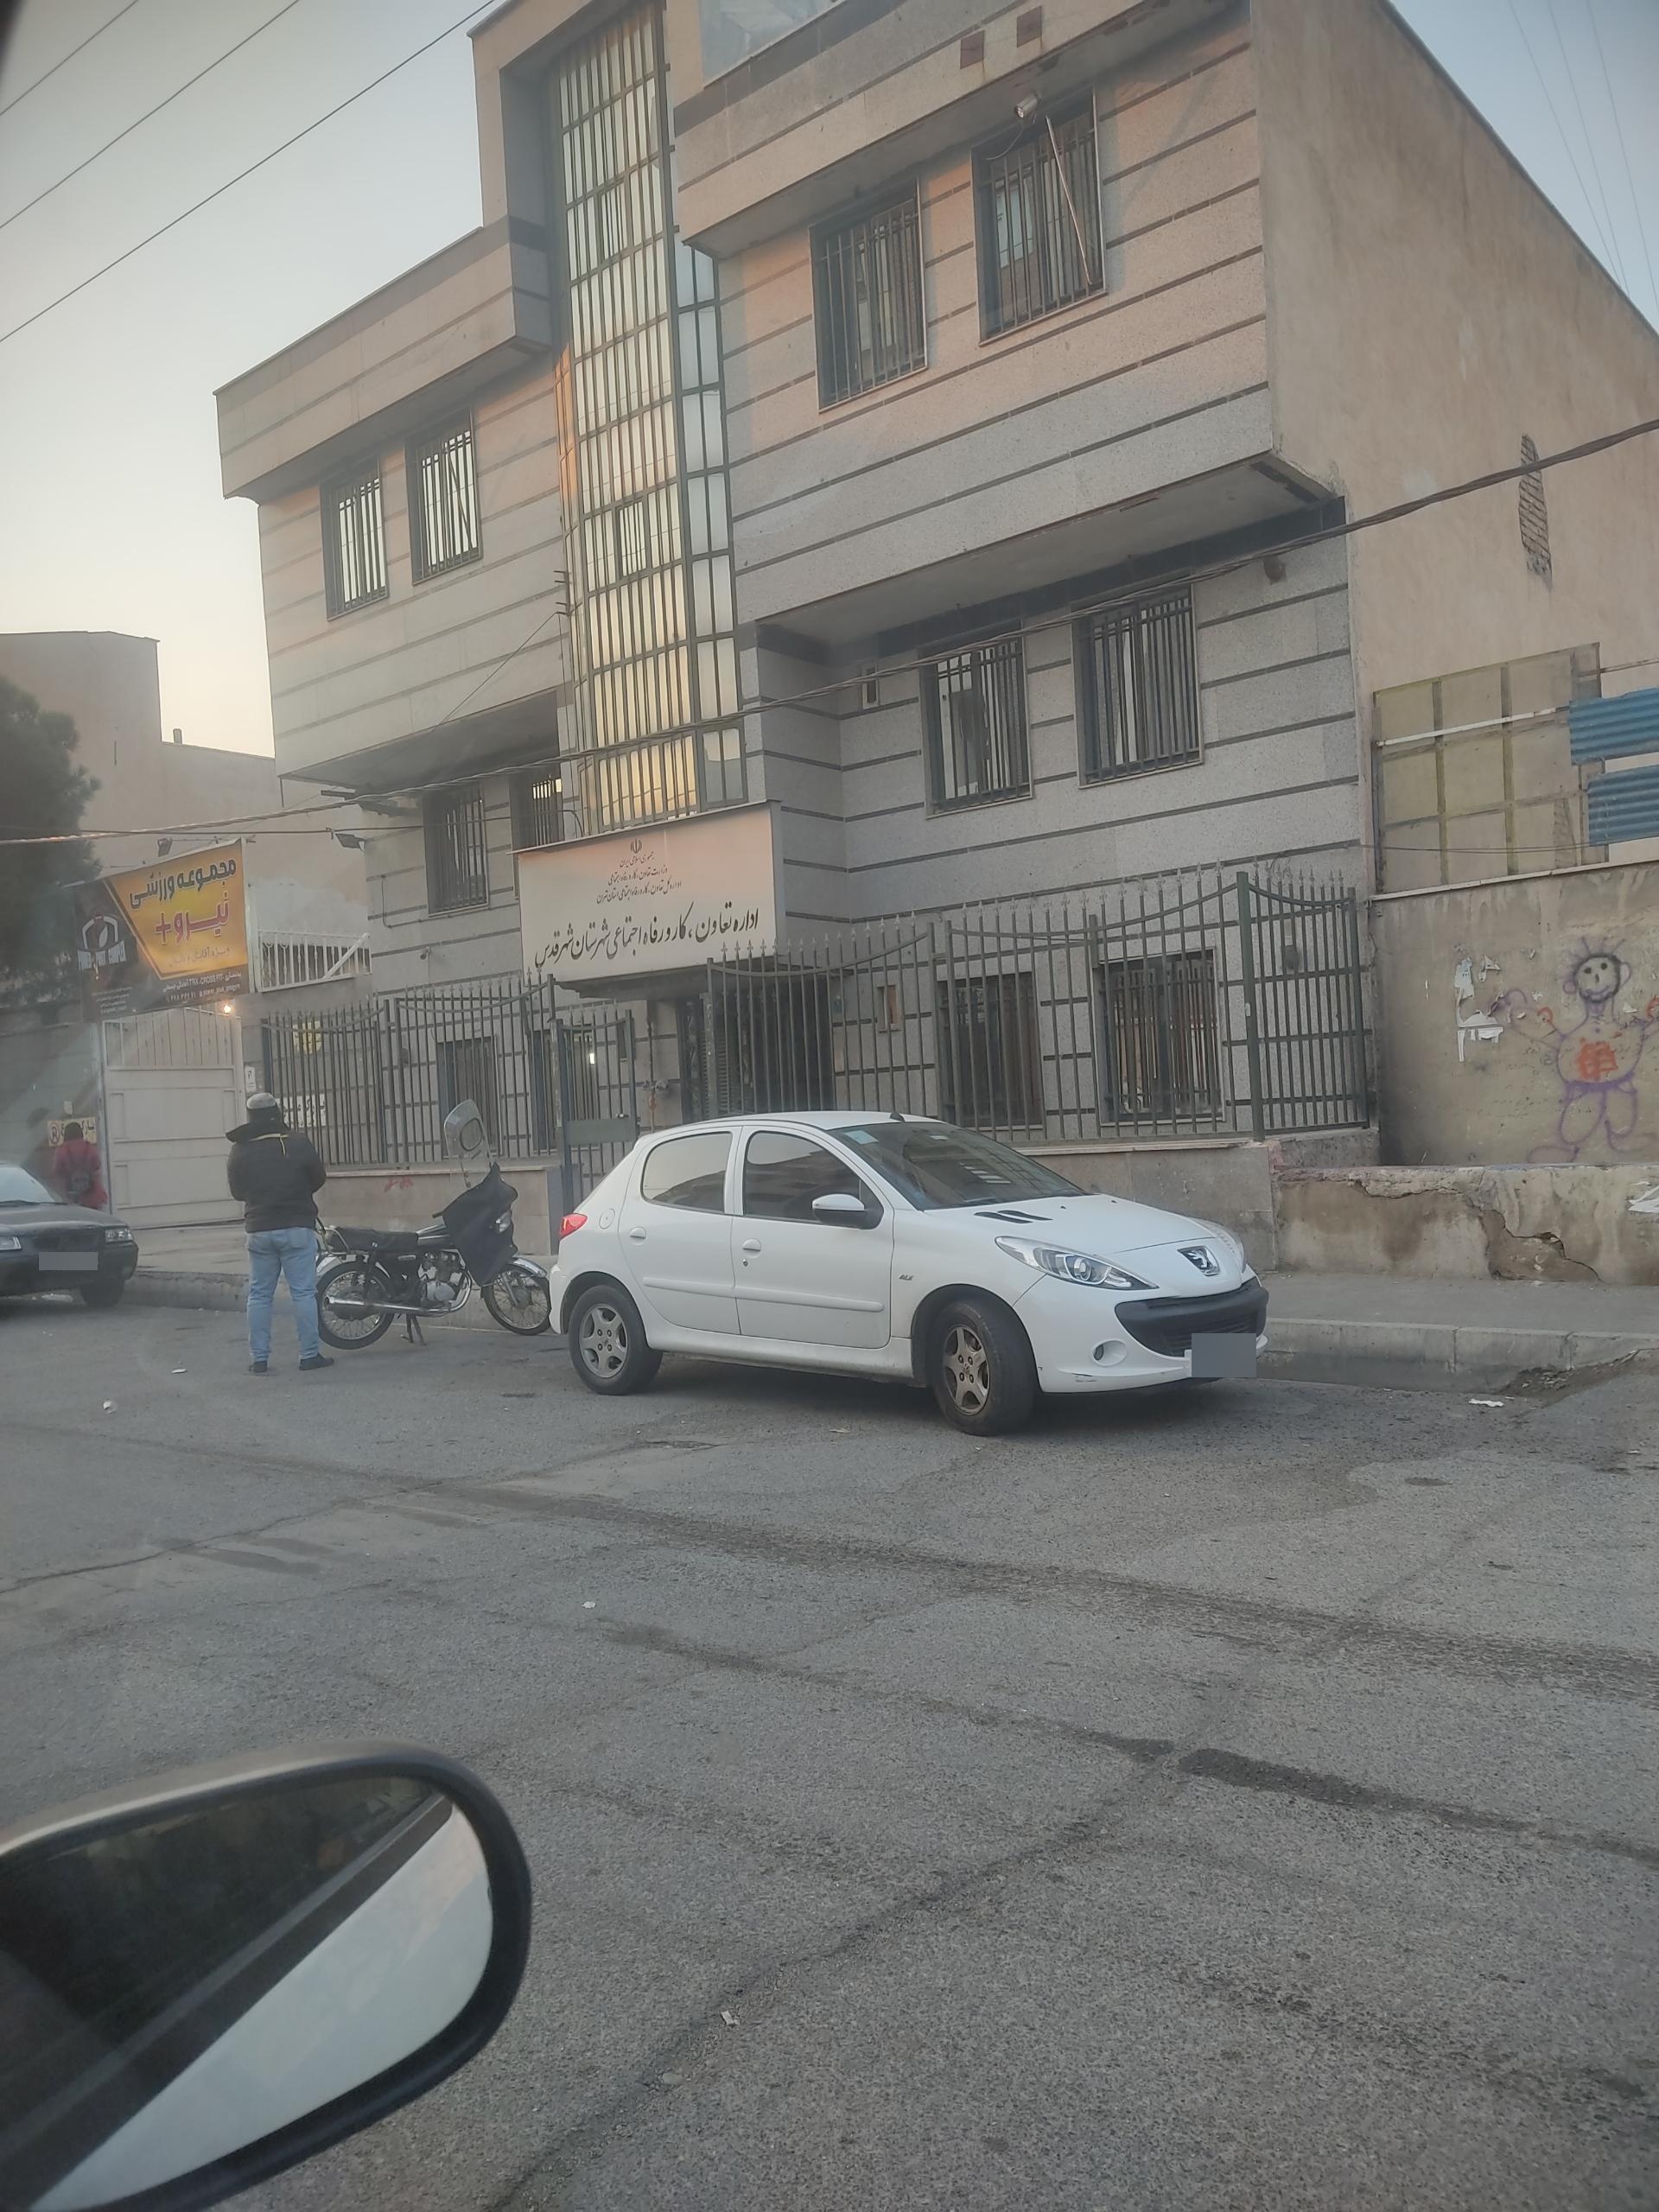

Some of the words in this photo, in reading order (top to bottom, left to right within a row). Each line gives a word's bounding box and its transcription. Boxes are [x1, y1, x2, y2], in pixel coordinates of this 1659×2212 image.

[130, 872, 175, 909] ورزشی
[176, 859, 237, 893] مجموعه
[607, 915, 642, 960] اجتماعی
[644, 916, 664, 945] رفاه
[664, 926, 671, 942] و
[671, 901, 694, 941] کار
[734, 907, 759, 932] اداره
[535, 930, 561, 969] قدس
[571, 918, 611, 960] شهرستان
